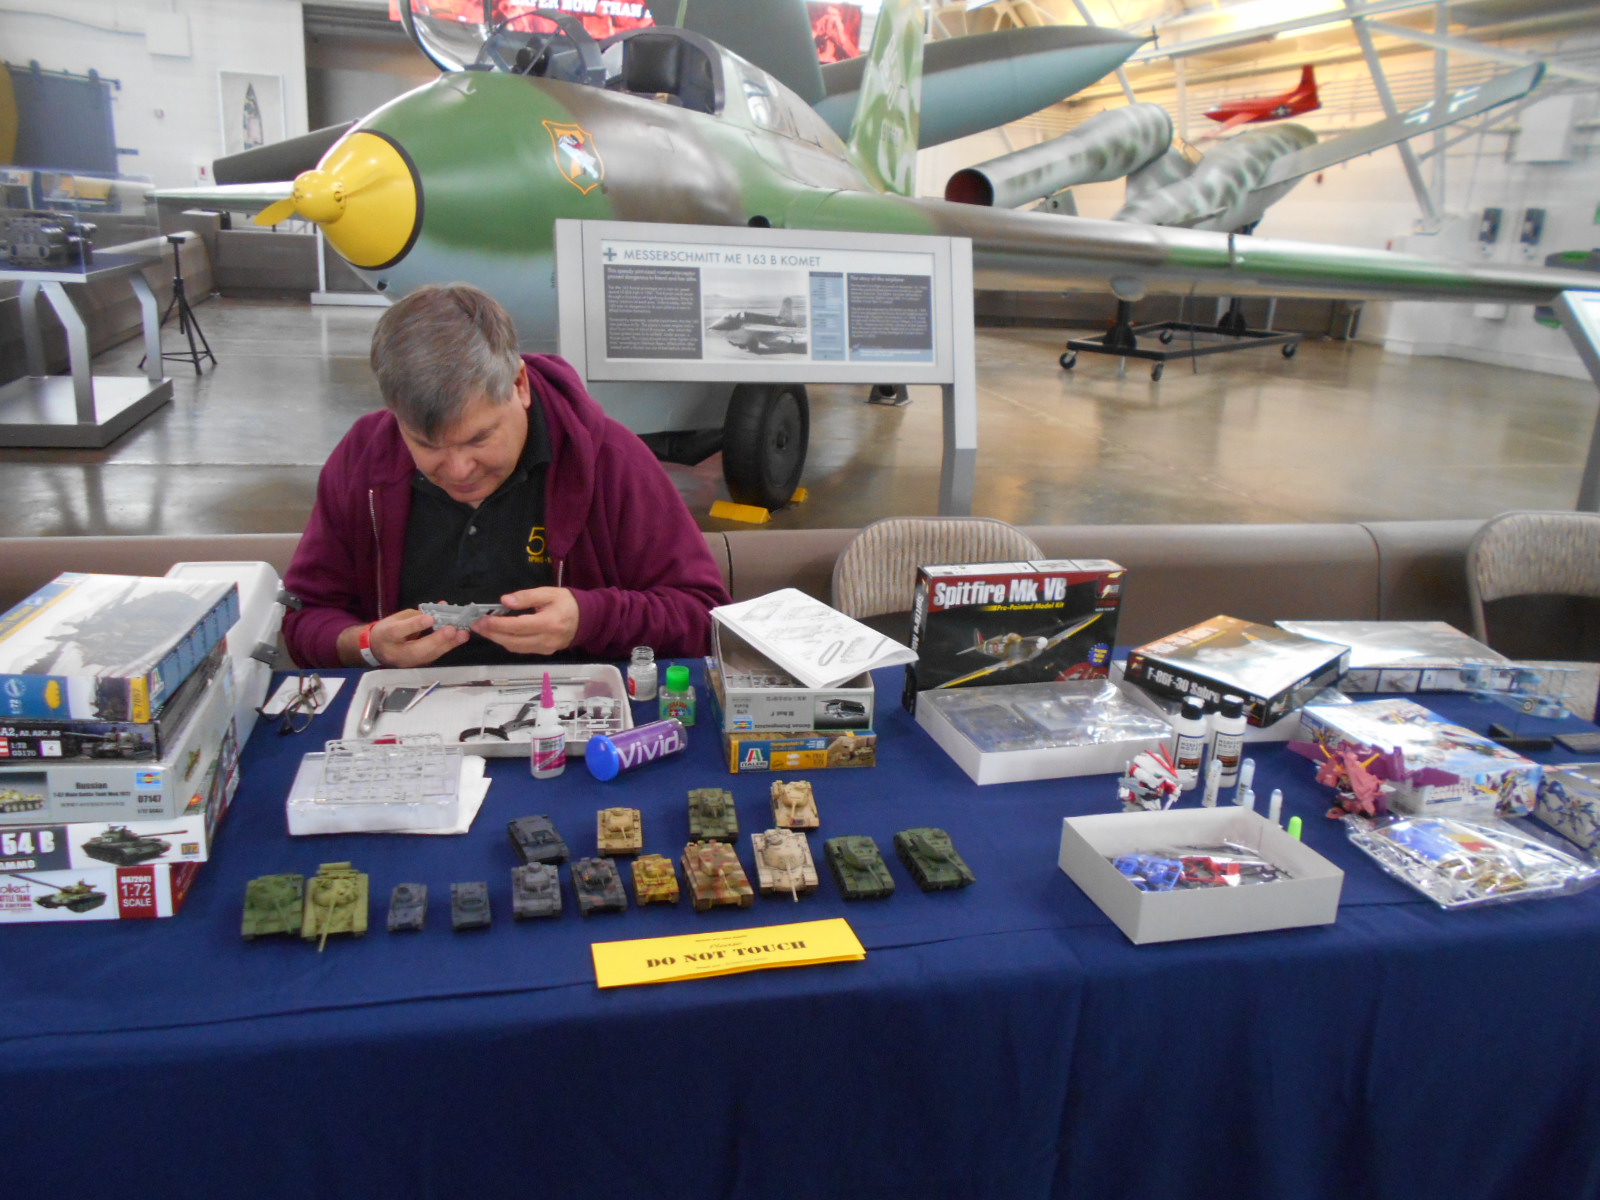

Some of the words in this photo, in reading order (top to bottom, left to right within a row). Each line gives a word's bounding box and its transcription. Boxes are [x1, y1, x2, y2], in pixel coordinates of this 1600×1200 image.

[623, 249, 721, 264] MESSERSCHMITT
[724, 252, 742, 264] ME
[746, 253, 767, 265] 163
[770, 254, 777, 265] B
[780, 255, 821, 267] KOMET
[933, 581, 1005, 609] Spitfire
[1008, 578, 1040, 602] Mk
[1043, 577, 1068, 601] VB
[996, 603, 1034, 611] Pre-Painted
[1189, 682, 1221, 704] Sabre
[121, 883, 152, 897] 1:72
[123, 898, 152, 908] SCALE
[646, 956, 676, 969] DO
[683, 950, 727, 963] NOT
[733, 940, 807, 956] TOUCH
